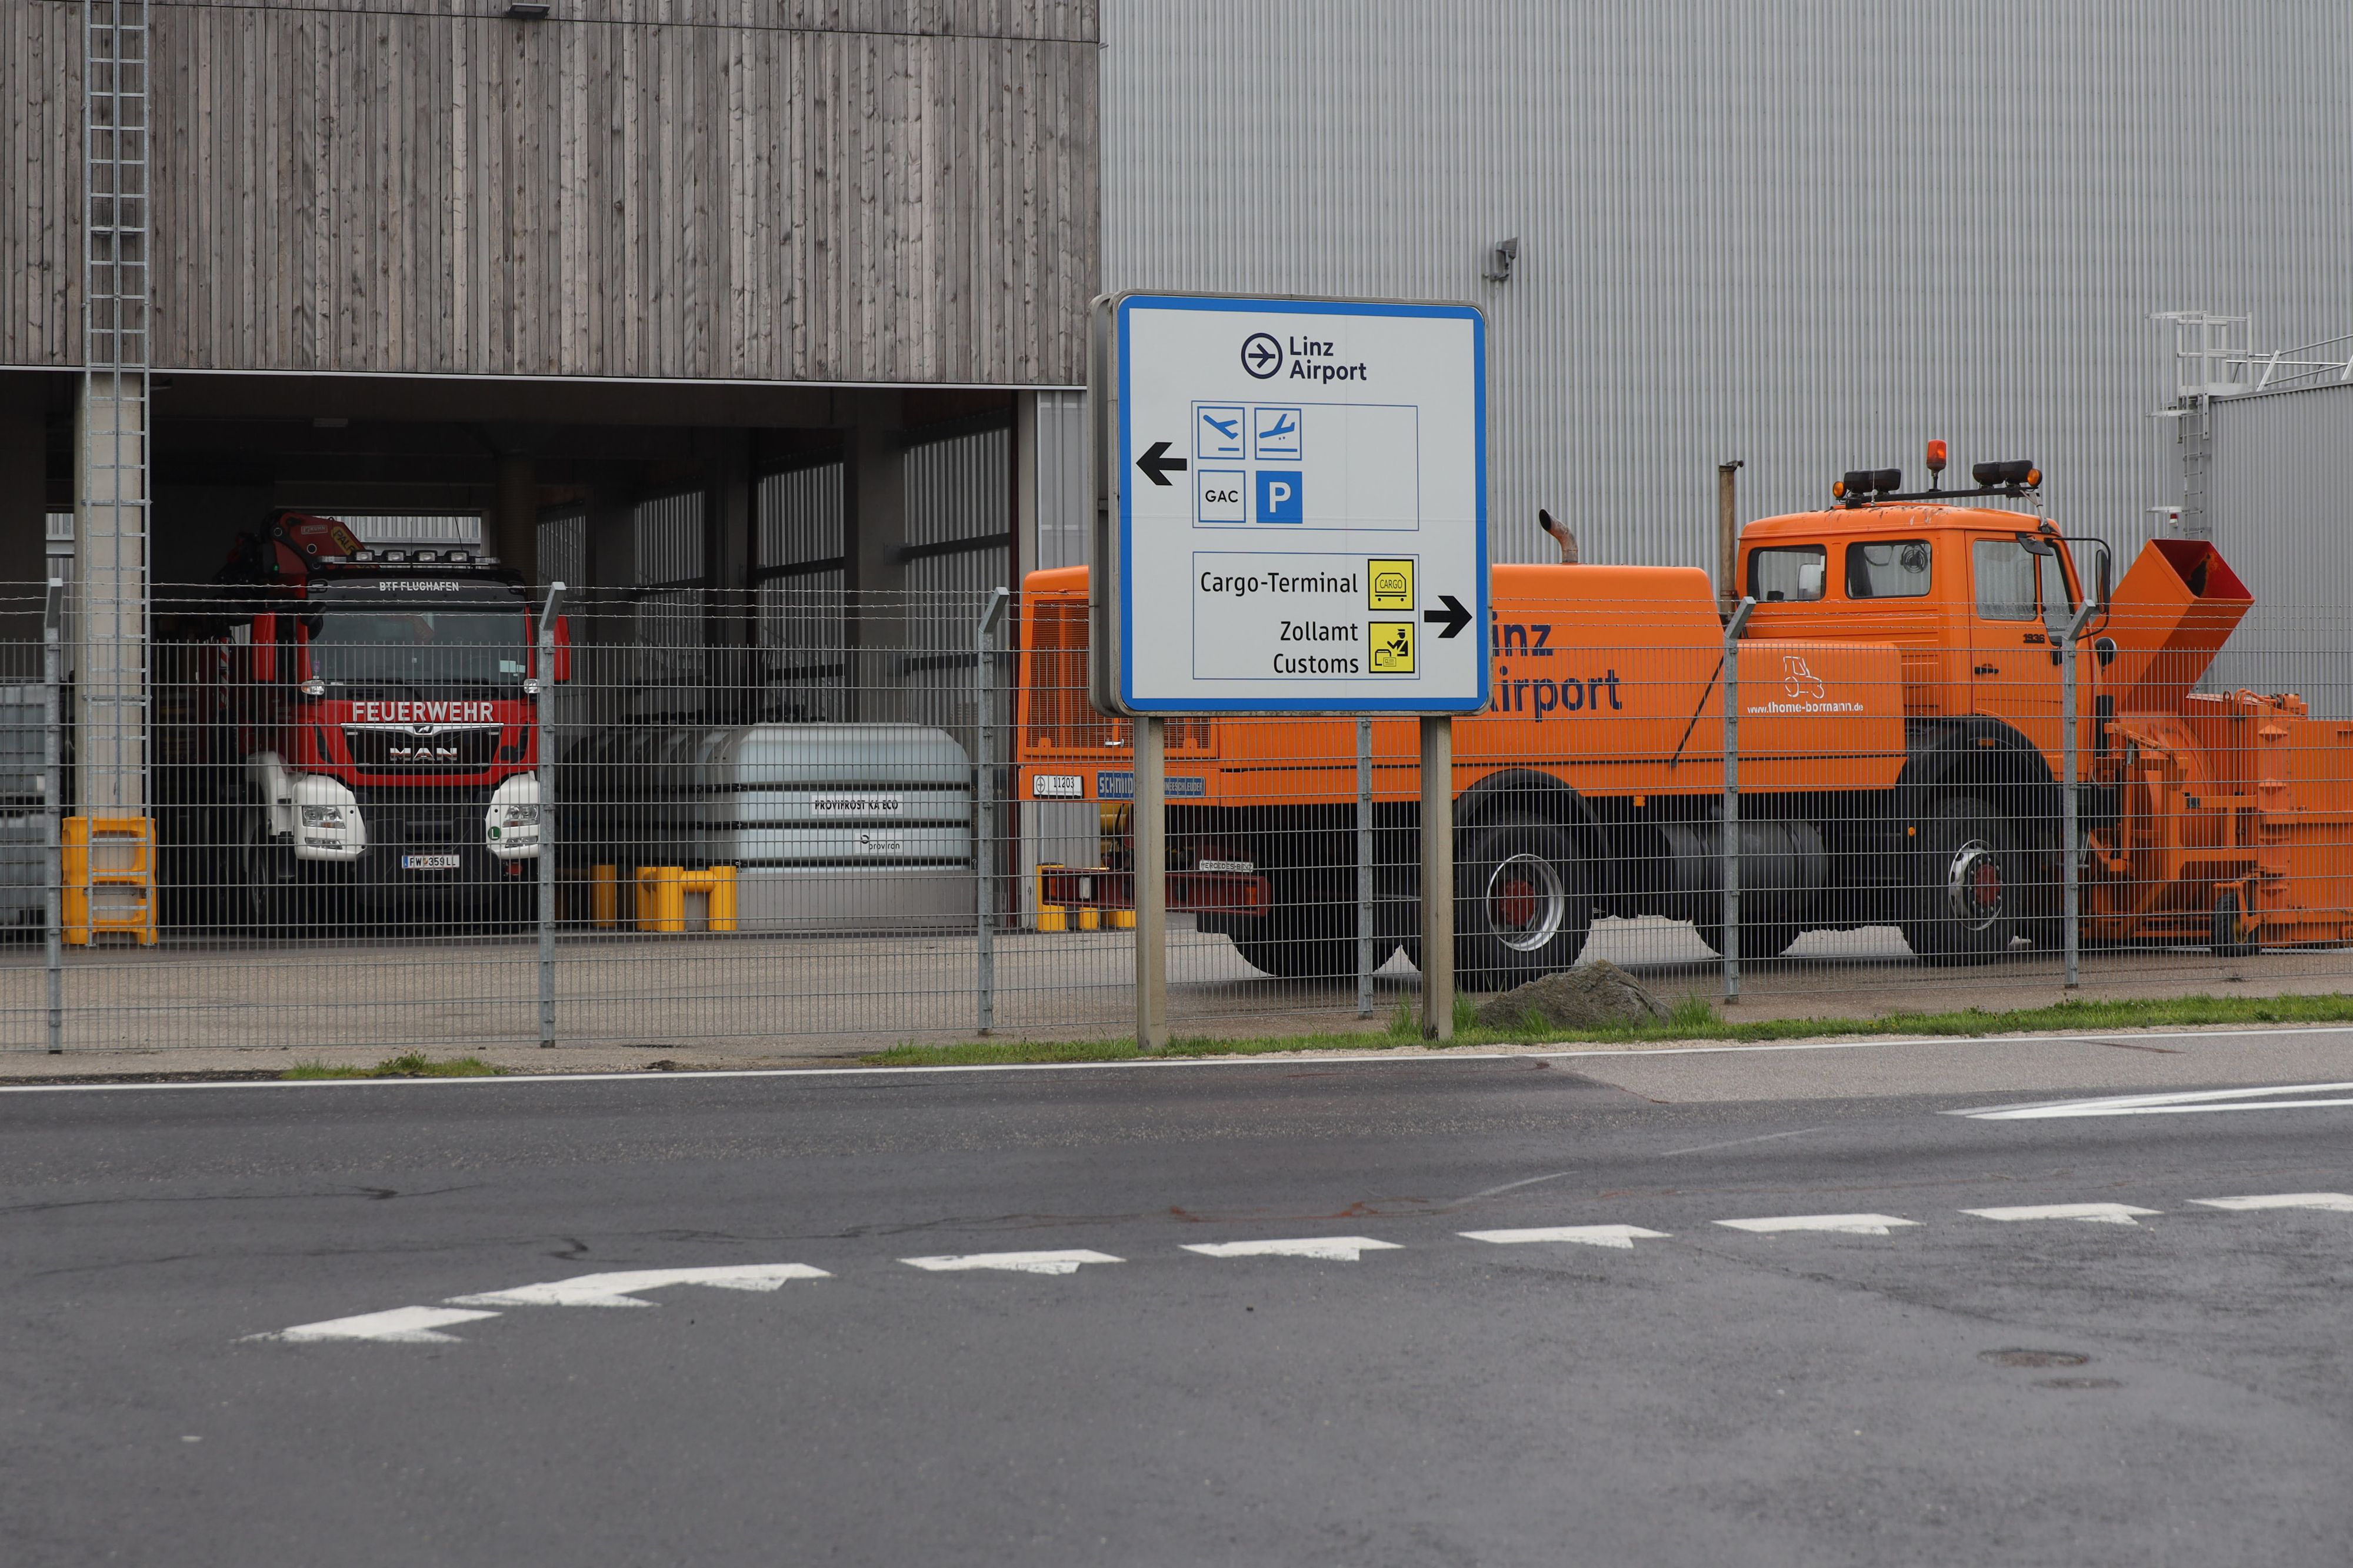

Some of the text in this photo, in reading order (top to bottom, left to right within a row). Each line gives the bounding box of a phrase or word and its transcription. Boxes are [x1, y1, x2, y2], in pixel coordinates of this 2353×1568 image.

[1289, 336, 1334, 356] Linz
[1289, 359, 1367, 385] Airport
[1205, 489, 1238, 503] GAC
[1269, 481, 1291, 513] P
[379, 581, 459, 592] BTF FLUGHAFEN
[1201, 572, 1358, 596] Cargo-Terminal
[1379, 579, 1402, 589] CARGO
[1280, 621, 1358, 641] Zollamt
[1492, 611, 1553, 657] inz
[1273, 653, 1359, 673] Customs
[352, 702, 494, 722] FEUERWEHR
[1747, 701, 1864, 713] www.thome-bormann.de
[390, 748, 457, 761] MAN
[1054, 777, 1074, 788] 11203
[1099, 777, 1203, 793] SCHMID NEESCHLEUDER
[491, 828, 499, 839] L
